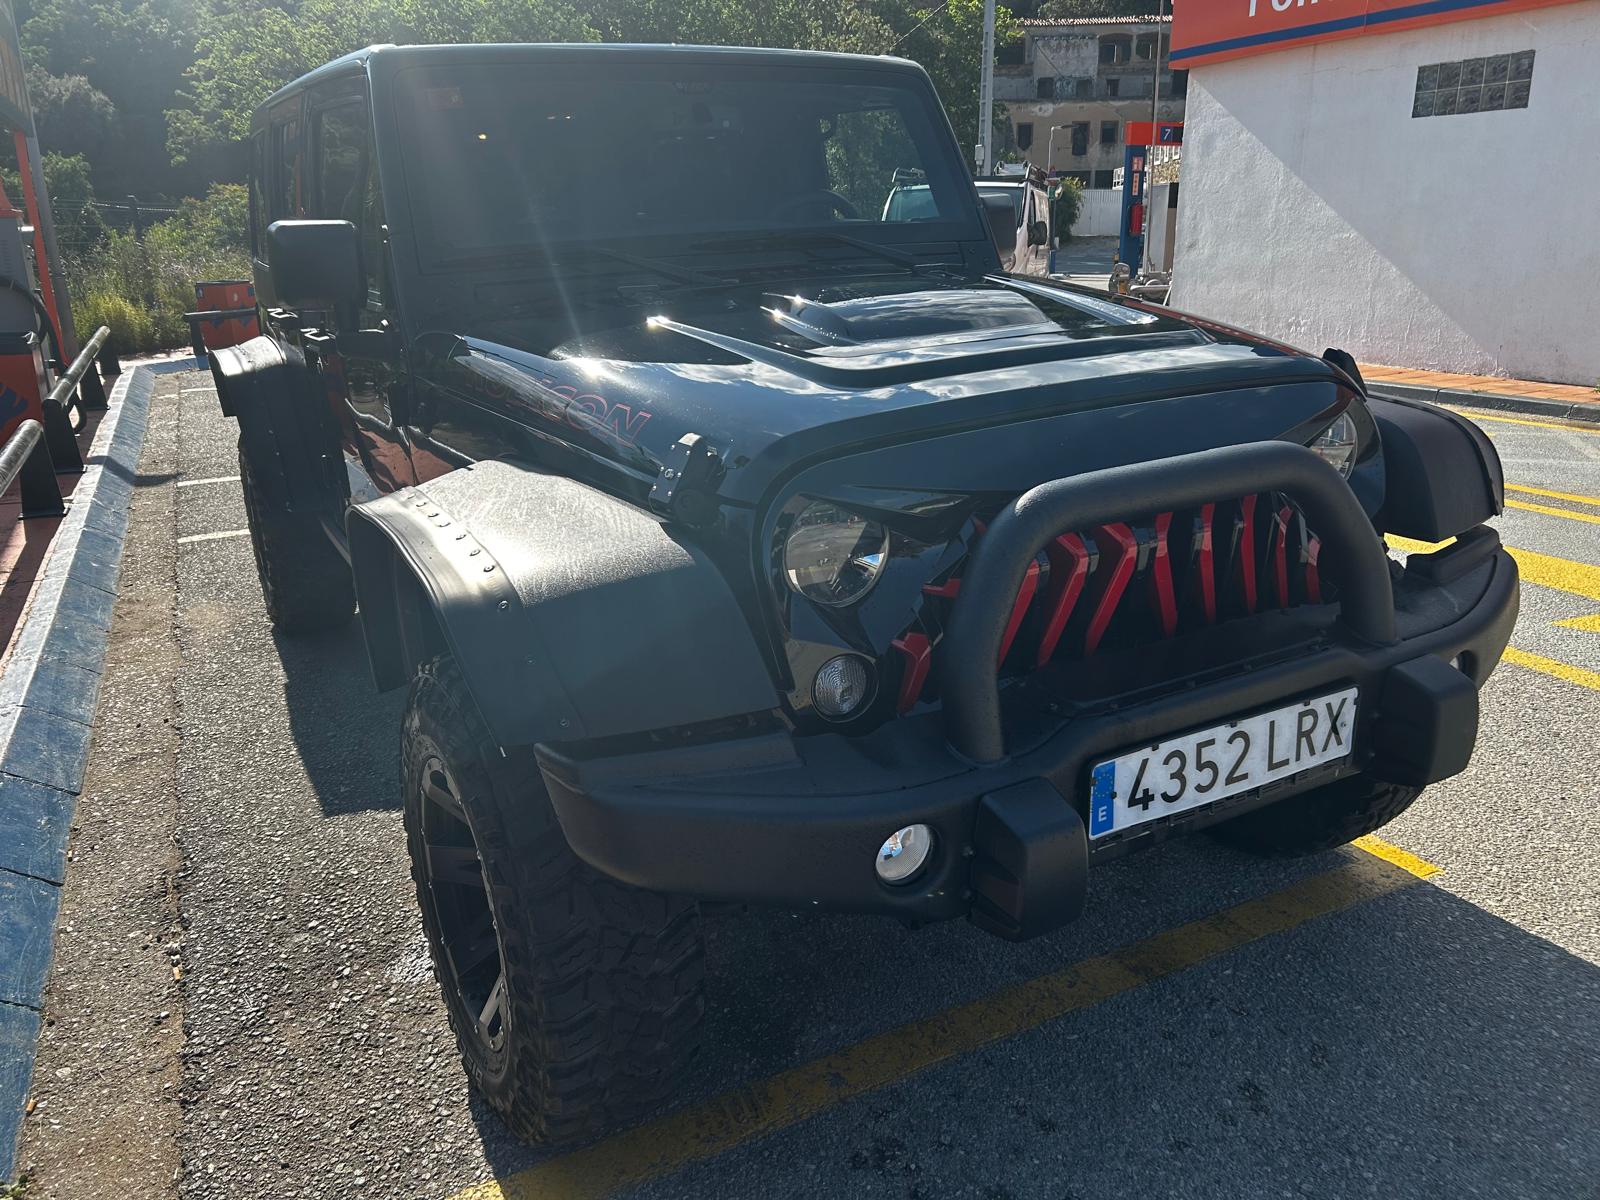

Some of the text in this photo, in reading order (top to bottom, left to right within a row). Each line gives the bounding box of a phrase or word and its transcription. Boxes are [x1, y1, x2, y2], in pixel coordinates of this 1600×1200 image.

[1164, 128, 1171, 140] 7
[1127, 697, 1348, 811] 4352 LRX
[1098, 806, 1107, 822] E
